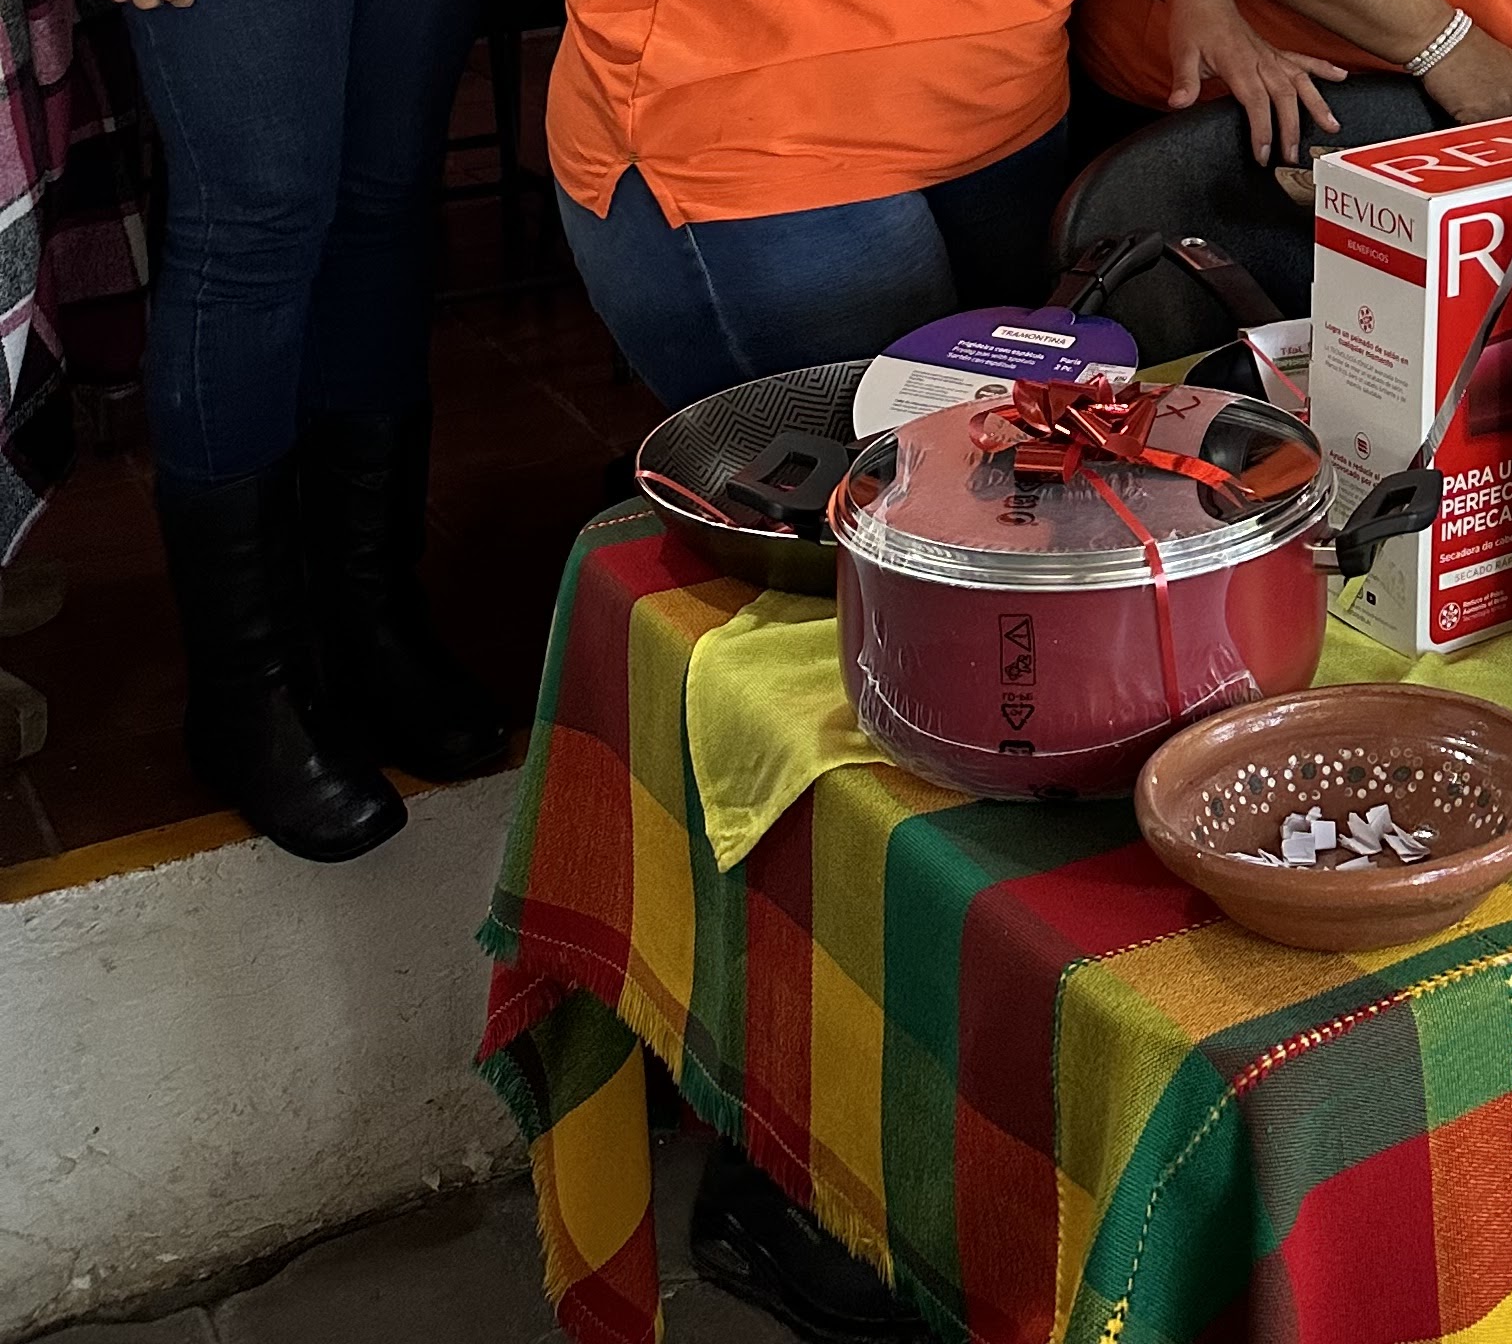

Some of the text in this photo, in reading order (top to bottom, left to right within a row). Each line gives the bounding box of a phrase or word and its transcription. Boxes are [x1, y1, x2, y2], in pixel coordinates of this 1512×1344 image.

[1324, 185, 1414, 243] REVLON
[1347, 238, 1390, 264] BENEFICIOS
[1001, 329, 1067, 346] TRAMONTINA
[1375, 345, 1383, 354] de
[1400, 357, 1409, 366] en
[1443, 465, 1495, 497] PARA
[1439, 543, 1480, 564] Secadora
[1482, 540, 1494, 552] de
[1454, 561, 1493, 582] SECADO
